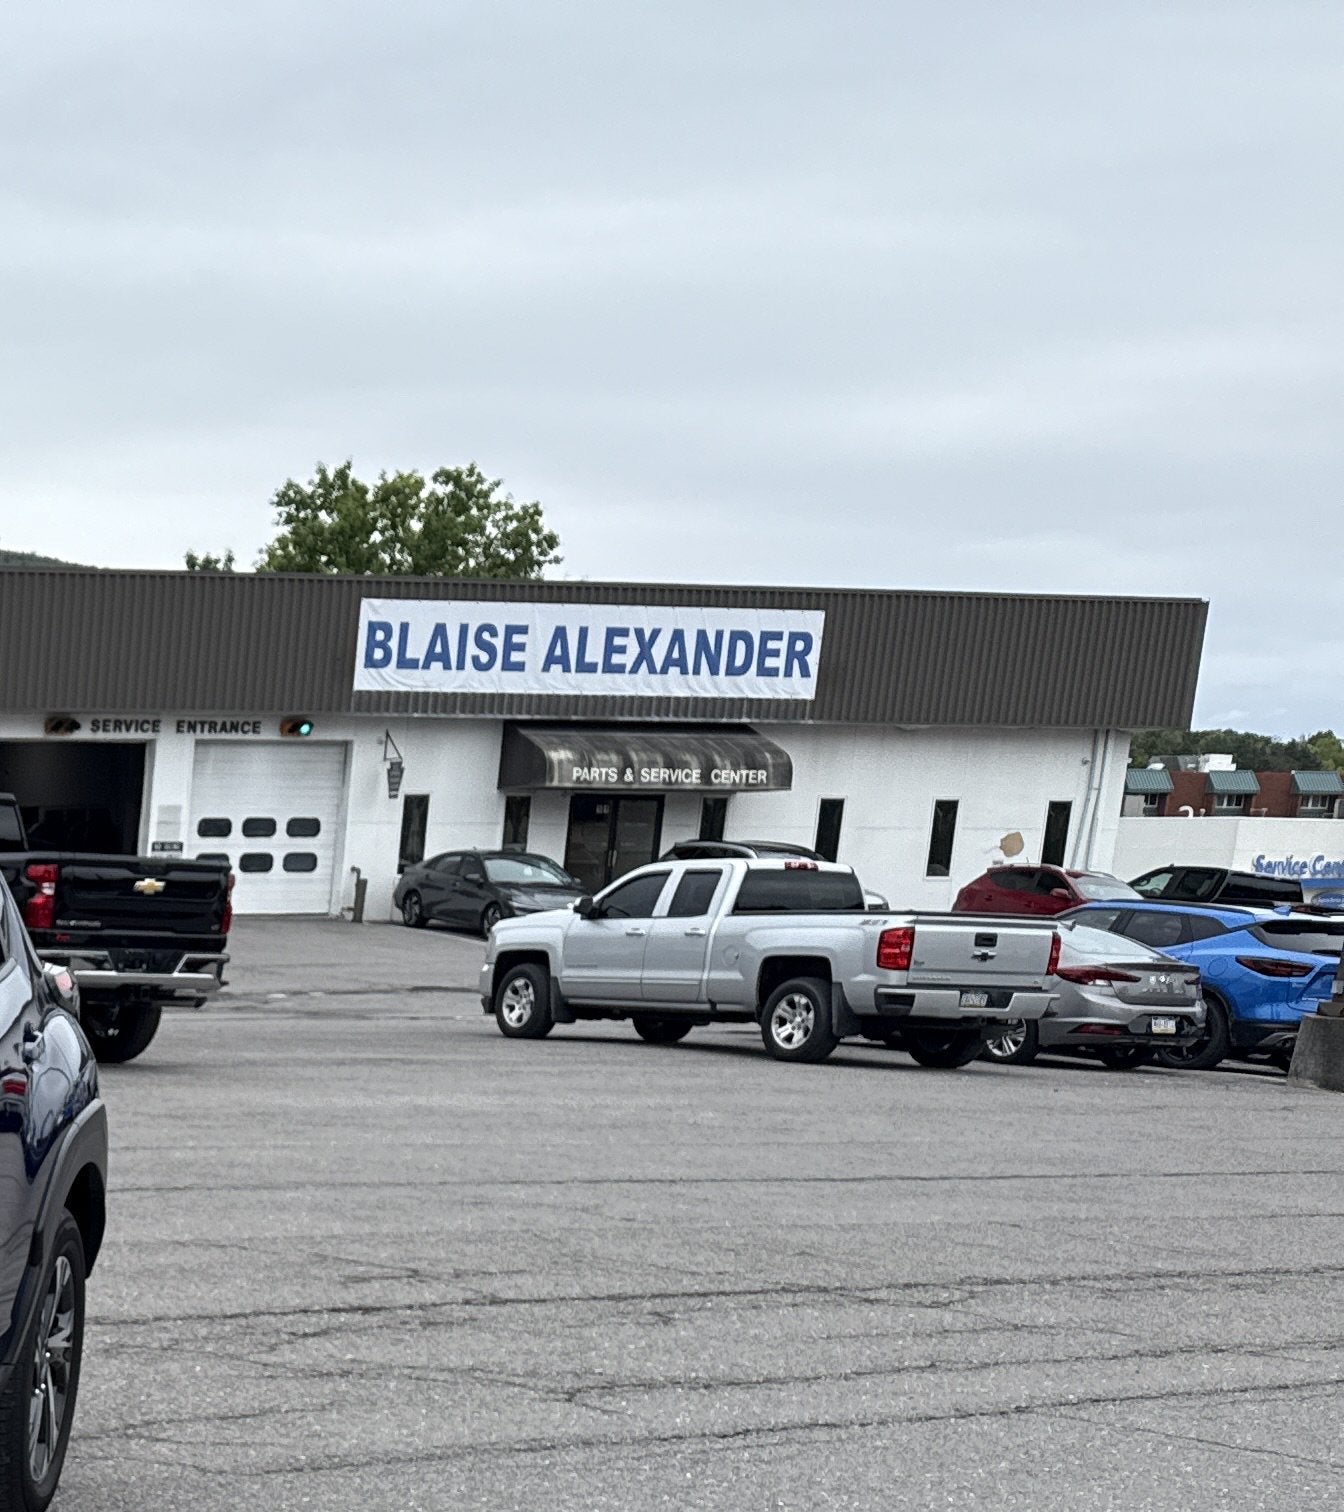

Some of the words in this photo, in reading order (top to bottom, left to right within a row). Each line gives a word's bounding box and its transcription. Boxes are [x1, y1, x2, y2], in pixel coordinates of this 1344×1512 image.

[363, 620, 529, 673] BLAISE
[541, 625, 813, 678] ALEXANDER
[90, 719, 161, 734] SERVICE
[176, 719, 261, 735] ENTRANCE
[572, 767, 618, 782] PARTS
[624, 767, 634, 783] &
[640, 768, 701, 784] SERVICE
[711, 769, 767, 784] CENTER
[1252, 854, 1308, 876] Service
